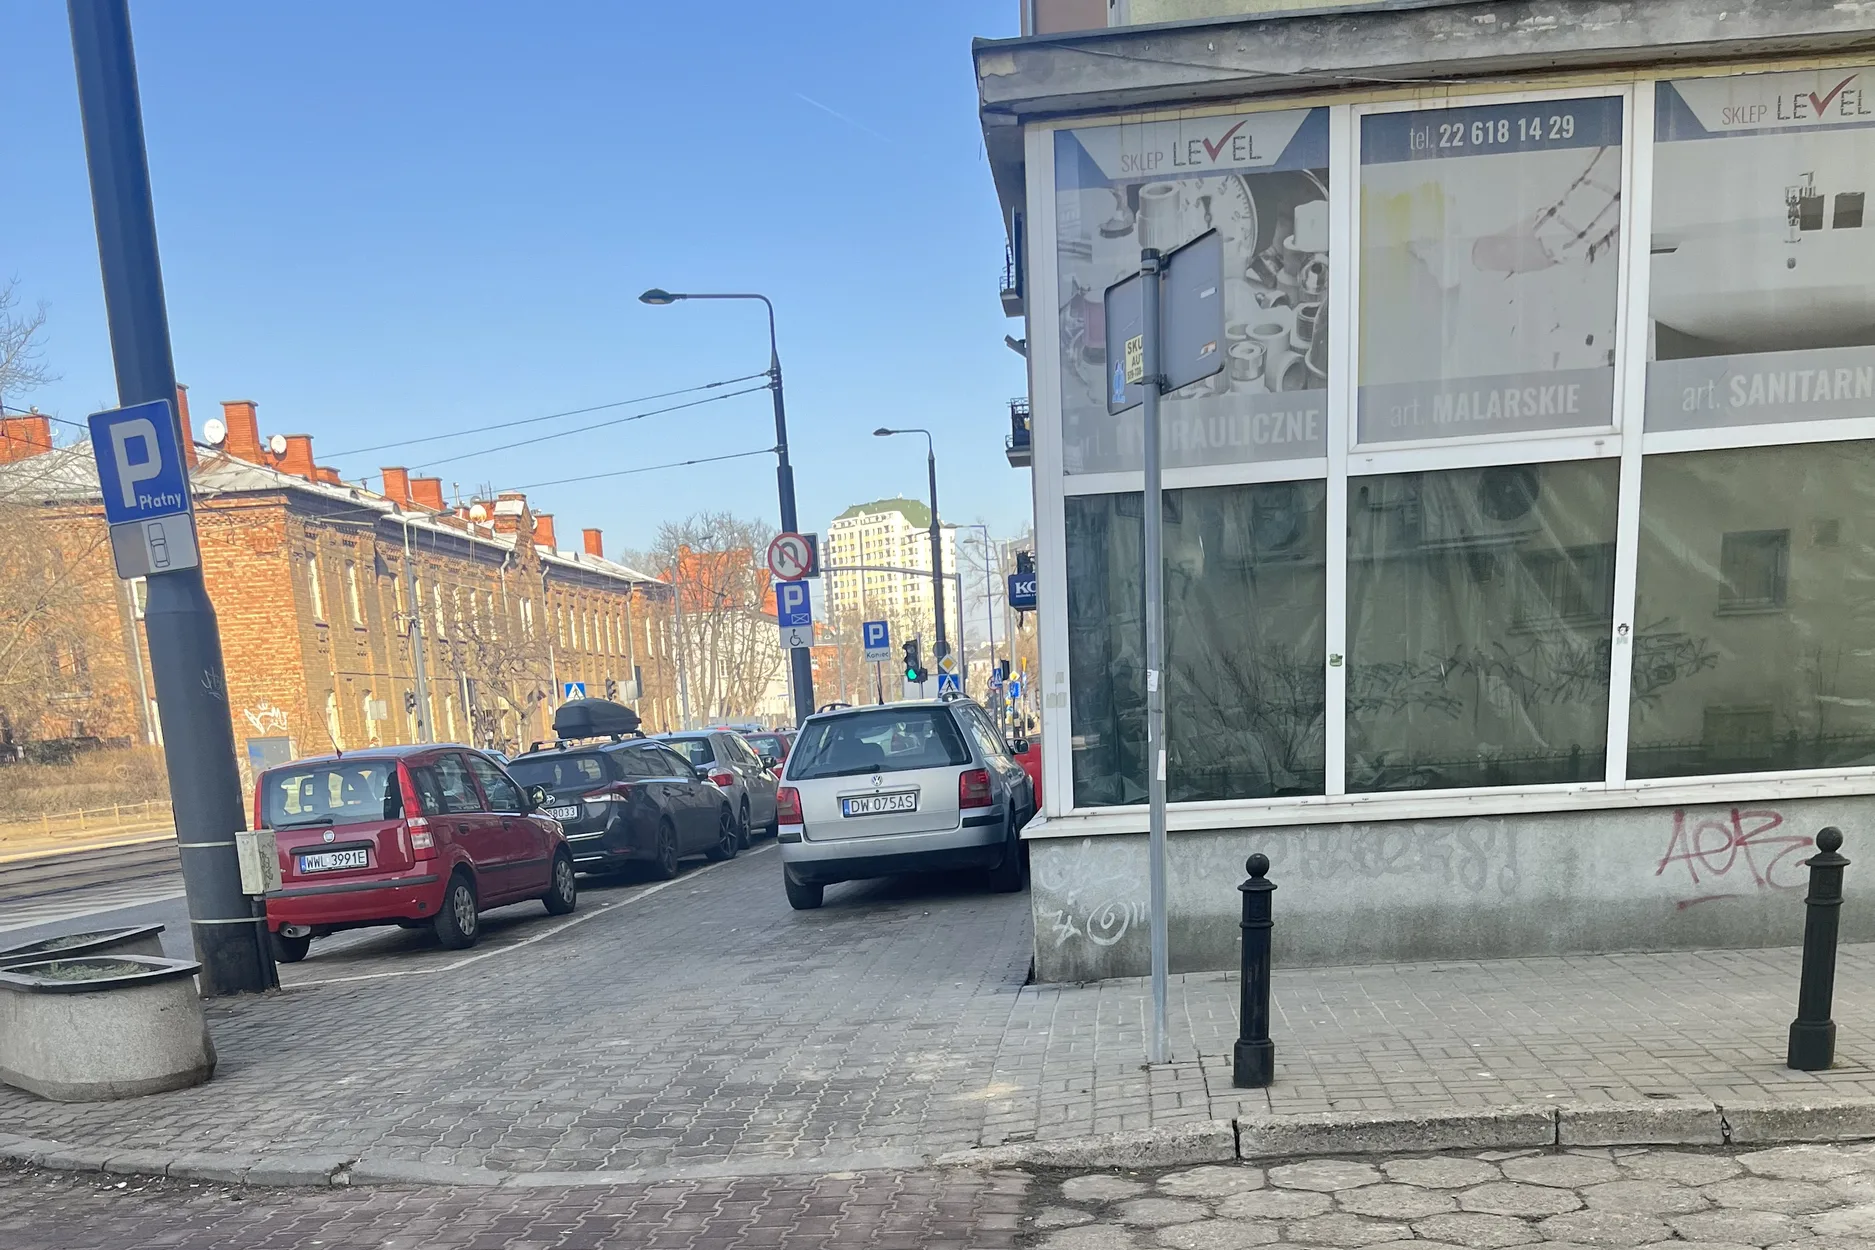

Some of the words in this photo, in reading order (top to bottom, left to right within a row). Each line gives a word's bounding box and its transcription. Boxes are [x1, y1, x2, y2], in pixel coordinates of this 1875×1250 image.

[1722, 105, 1767, 125] SKLEP
[1777, 73, 1872, 121] LEVEL
[1121, 151, 1164, 173] SKLEP
[1173, 120, 1262, 167] LEVEL
[1410, 125, 1435, 150] tel.
[1439, 122, 1465, 148] 22
[1471, 119, 1510, 145] 618
[1517, 116, 1542, 142] 14
[1549, 114, 1575, 139] 29
[1390, 398, 1425, 428] art.
[1433, 384, 1580, 423] MALARSKIE
[1682, 379, 1720, 412] art.
[109, 418, 162, 508] P
[139, 492, 182, 511] Płatny
[783, 584, 803, 614] P
[868, 624, 884, 646] P
[866, 651, 889, 659] Koniec
[851, 799, 869, 813] DW
[306, 855, 328, 870] WWL
[331, 850, 366, 866] 3991E
